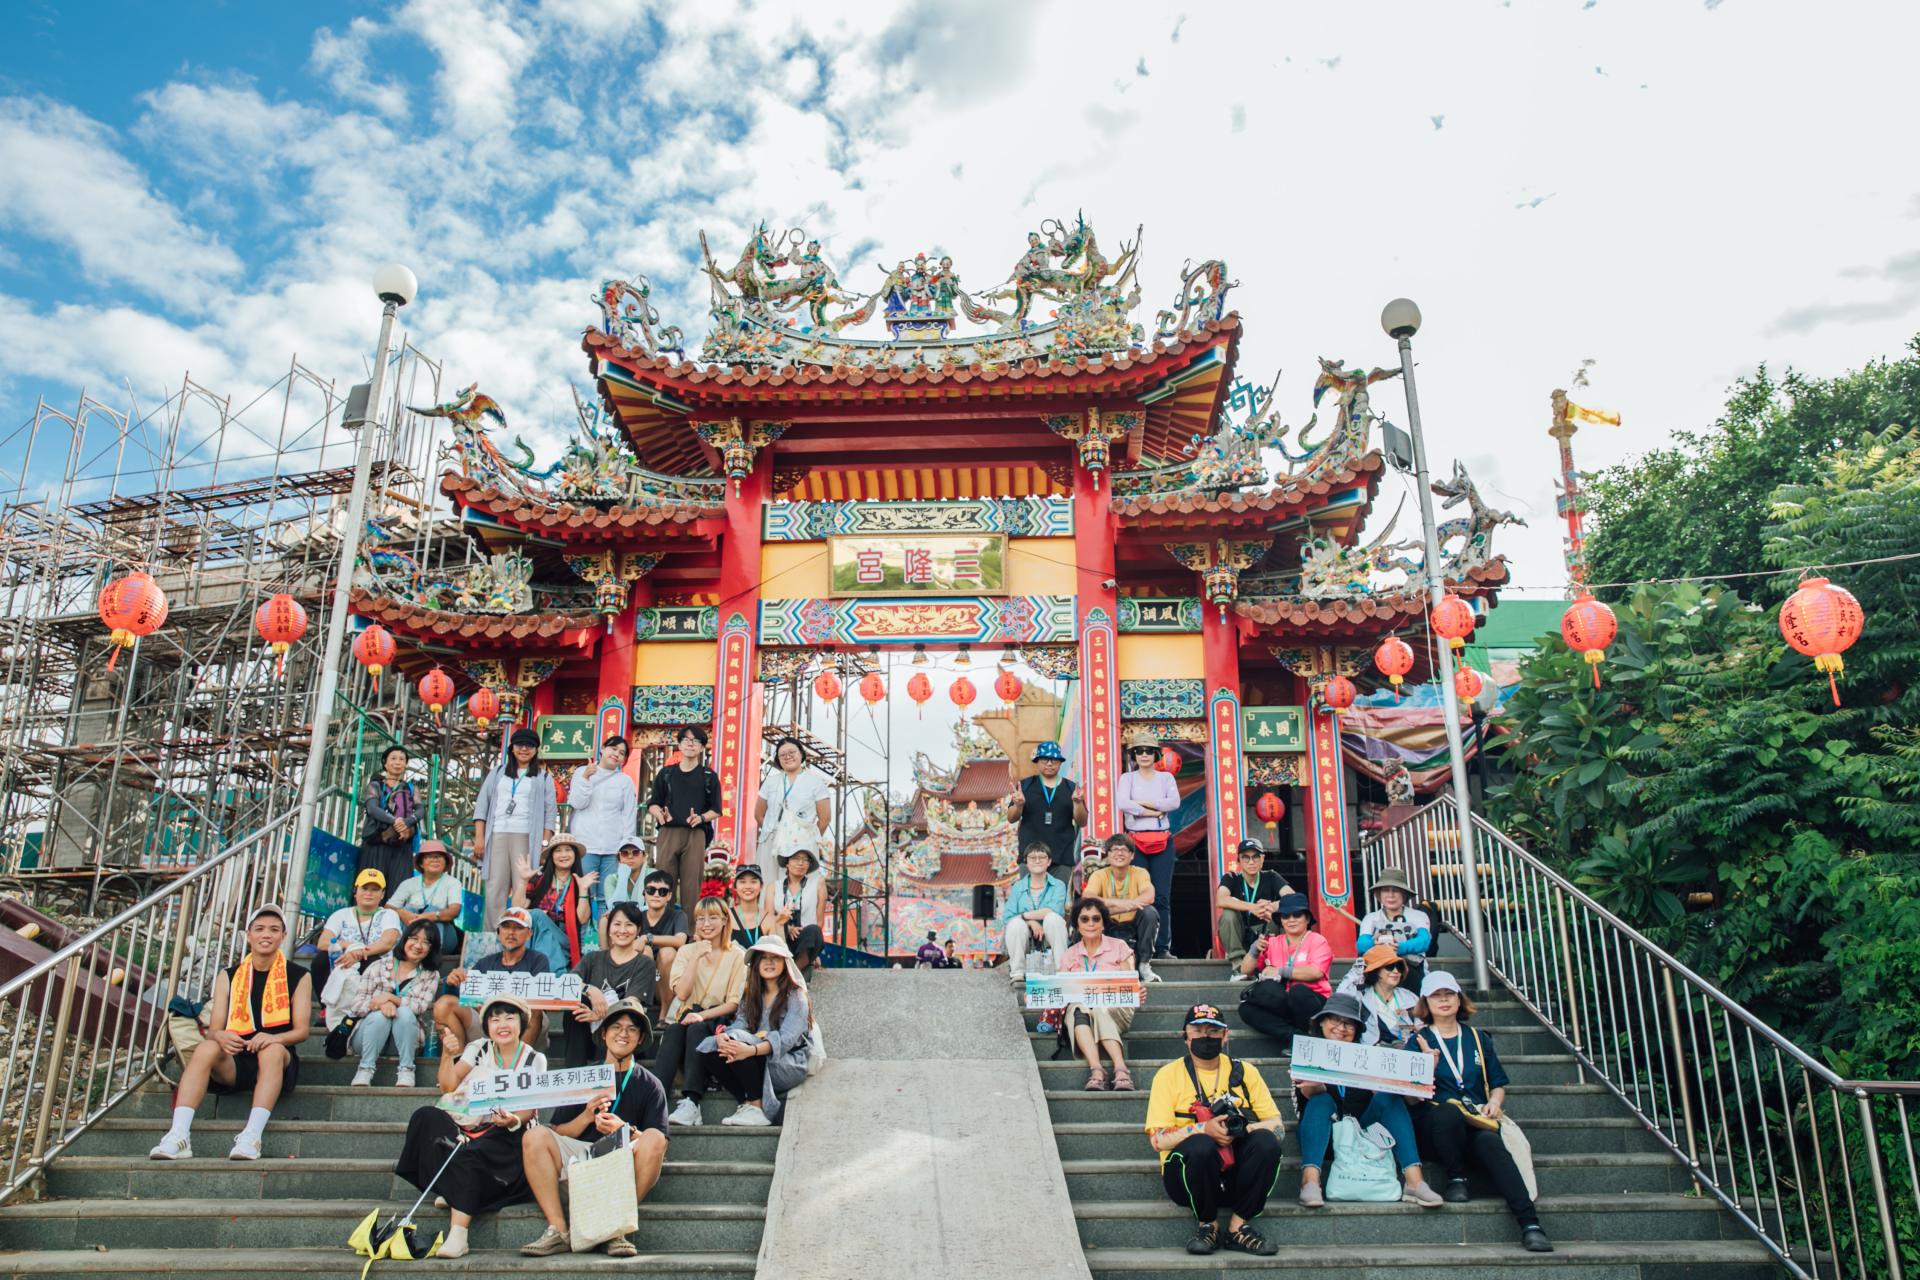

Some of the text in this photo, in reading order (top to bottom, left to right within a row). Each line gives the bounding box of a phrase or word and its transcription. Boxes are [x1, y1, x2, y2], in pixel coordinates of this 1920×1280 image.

[856, 547, 981, 584] 三隆宮
[462, 974, 580, 998] 產業新世代
[472, 1069, 613, 1096] 近50場系列活動
